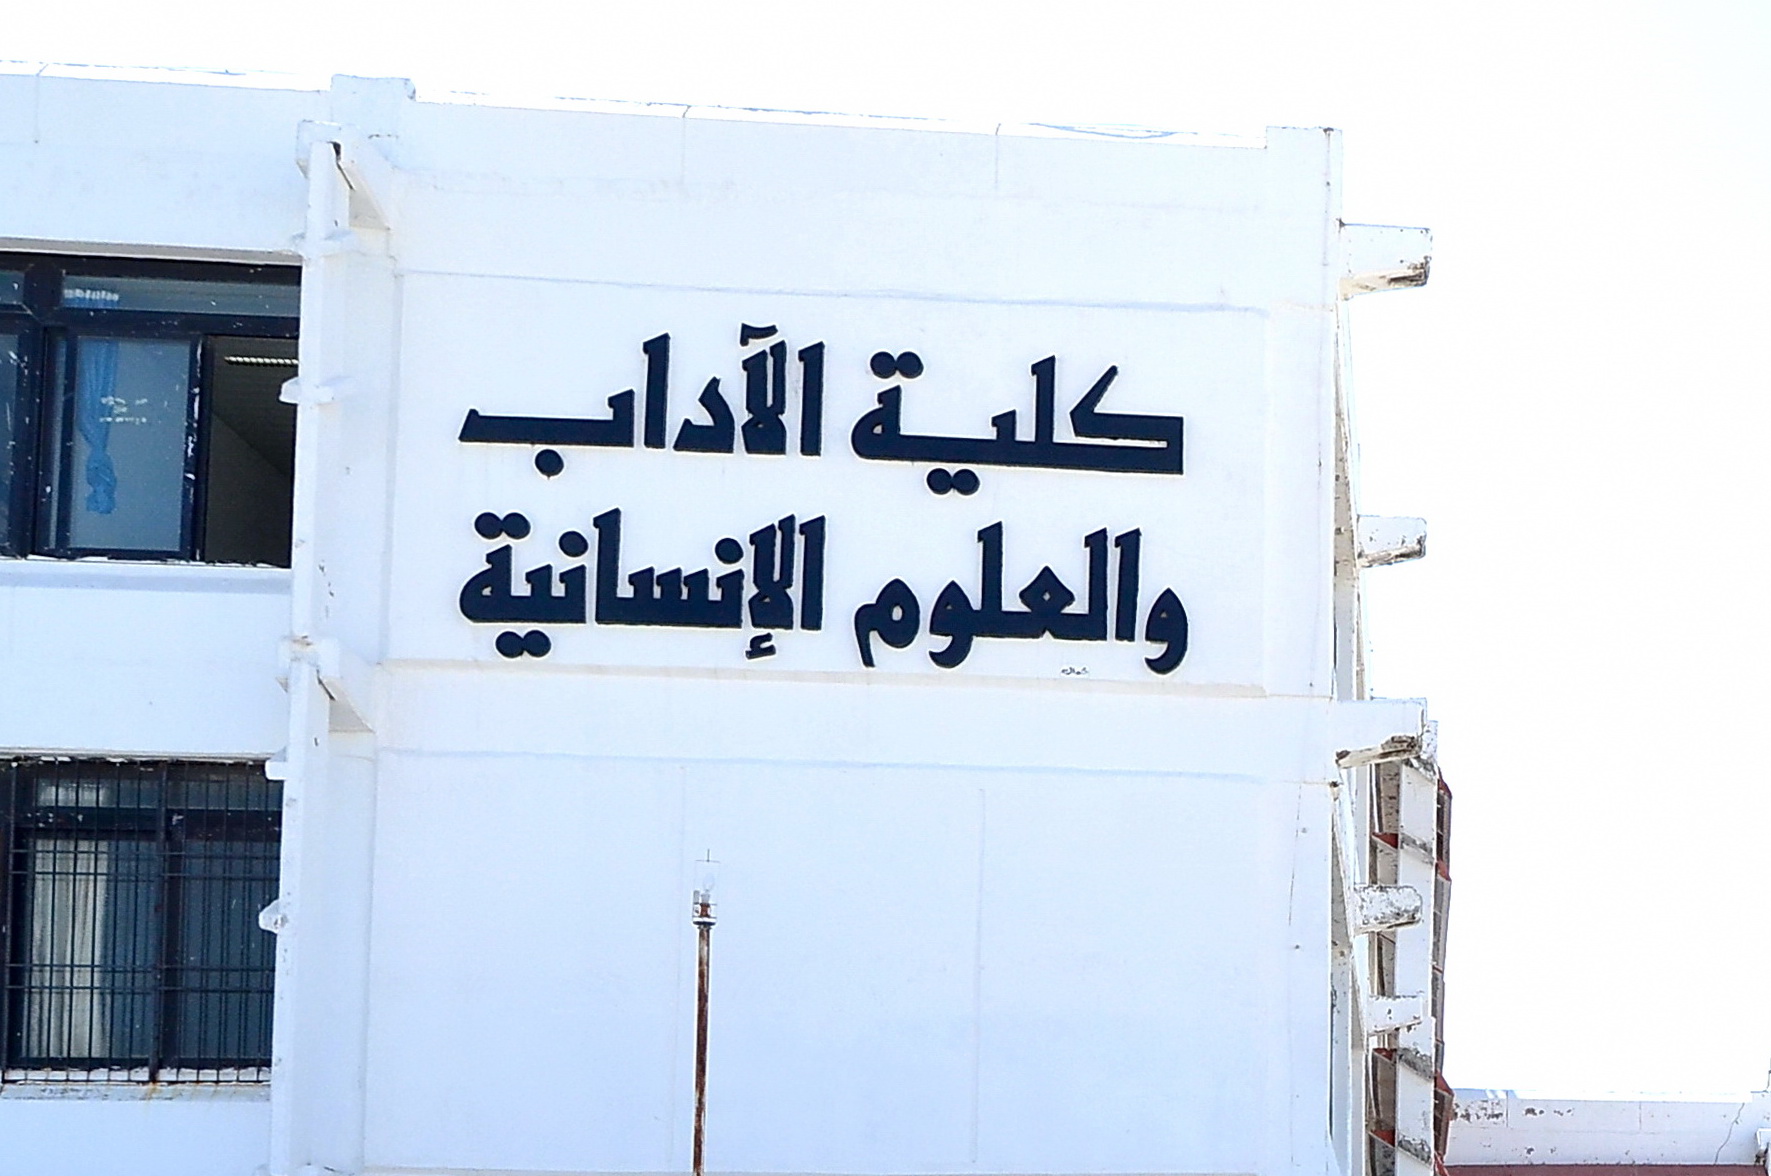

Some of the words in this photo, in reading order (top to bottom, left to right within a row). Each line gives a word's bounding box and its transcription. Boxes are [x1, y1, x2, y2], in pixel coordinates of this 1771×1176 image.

[458, 323, 826, 478] الآداب
[851, 351, 1185, 496] كلية
[459, 507, 826, 660] الإنسانية
[854, 520, 1189, 675] والعلوم
